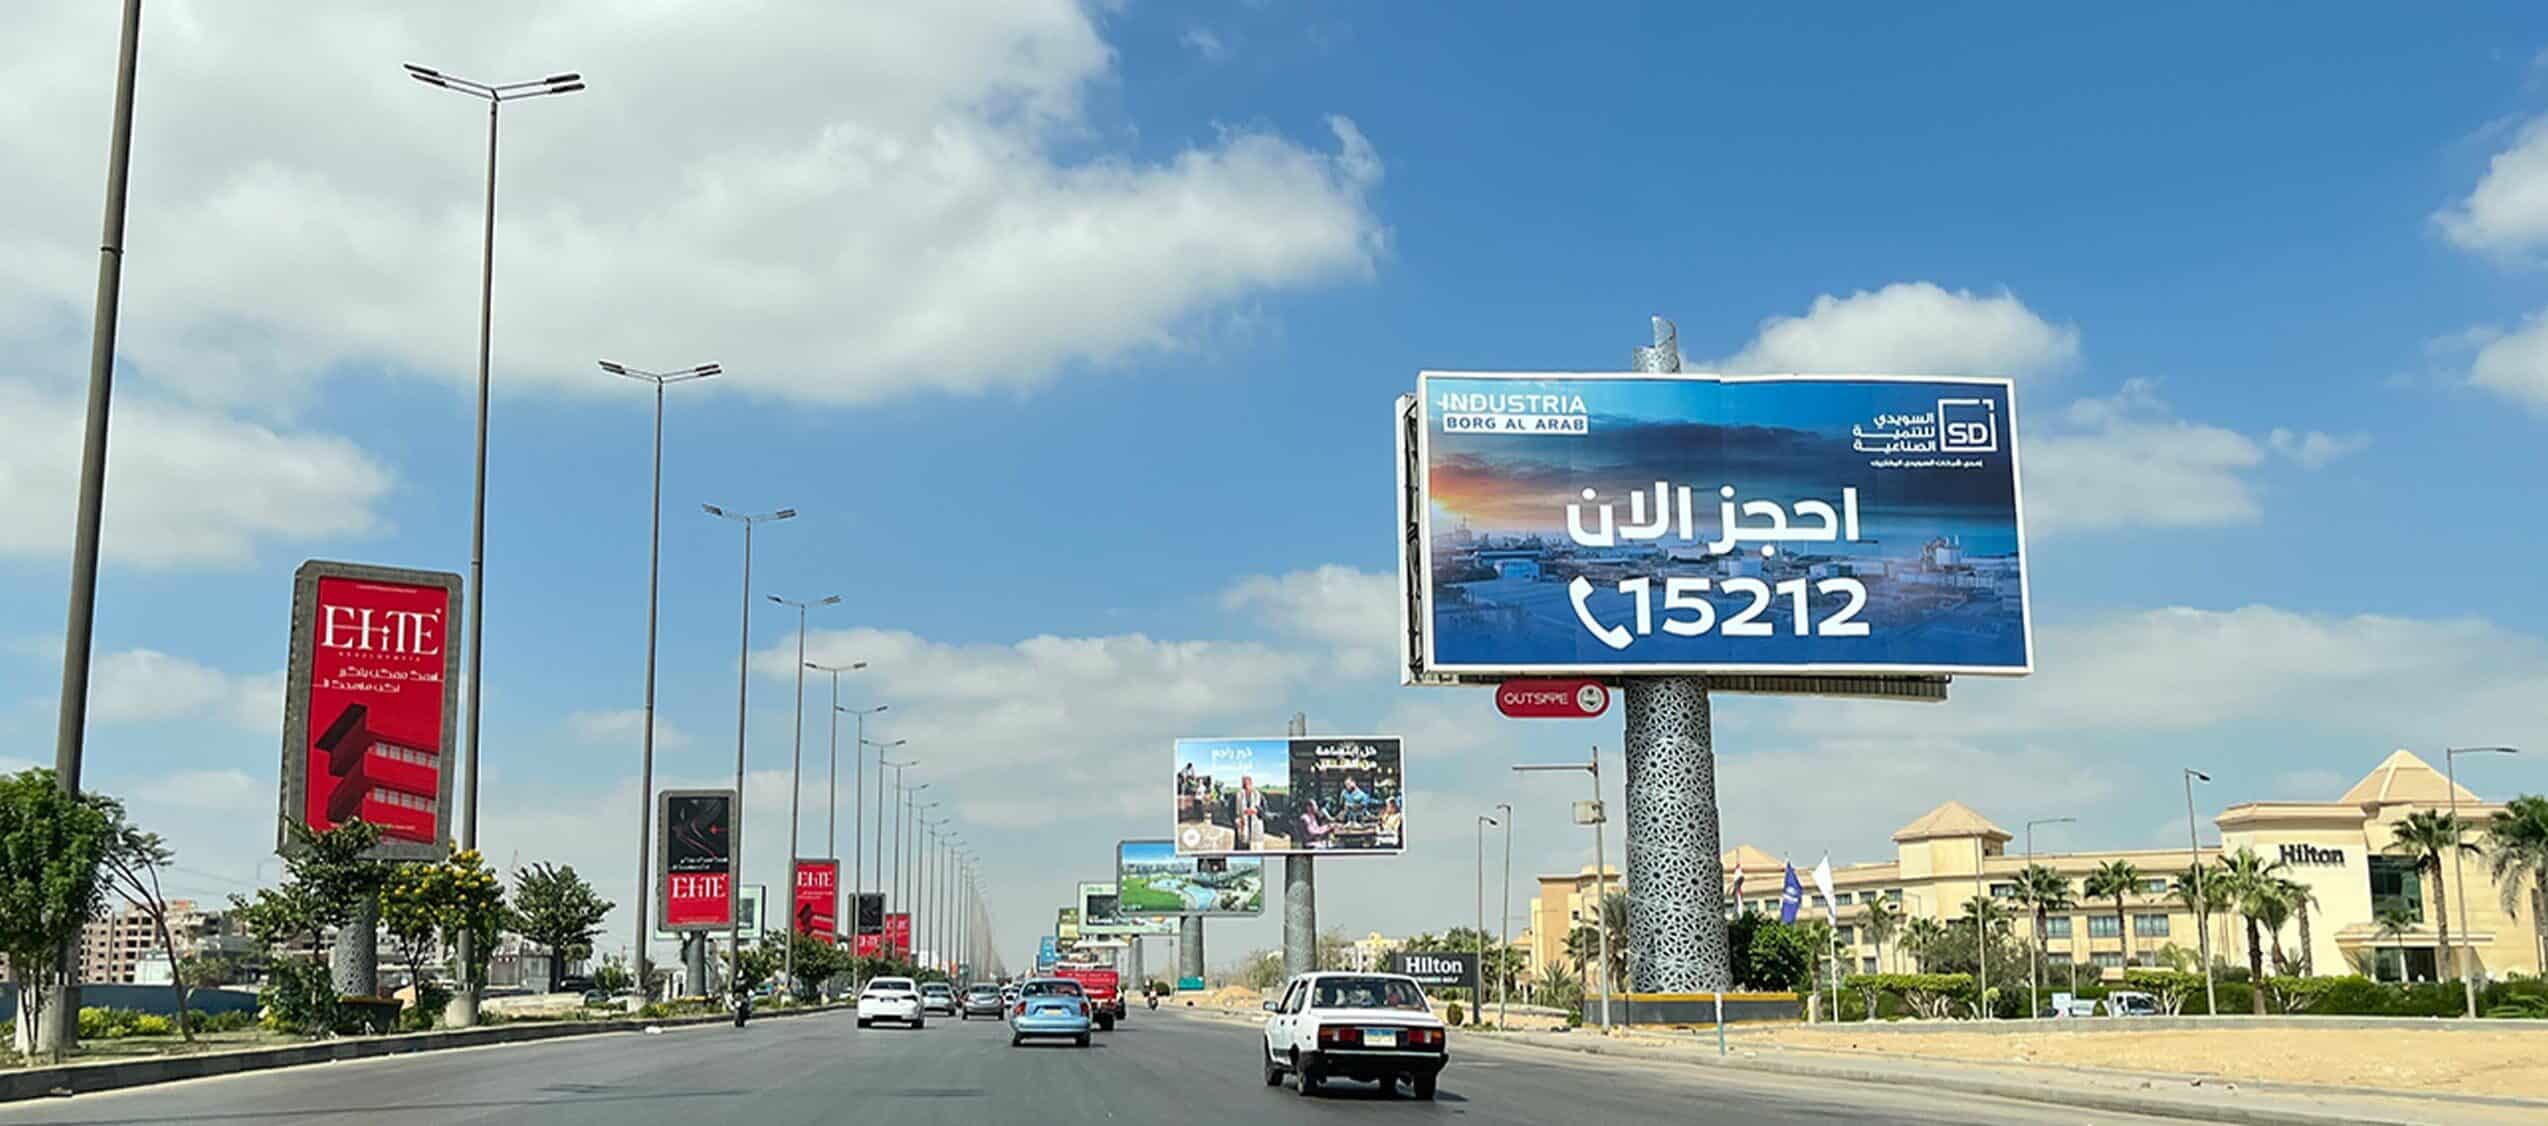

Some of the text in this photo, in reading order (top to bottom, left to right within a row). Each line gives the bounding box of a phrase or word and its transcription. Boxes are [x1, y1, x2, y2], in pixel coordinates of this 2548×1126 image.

[1438, 392, 1587, 414] INDUSTRIA
[1447, 416, 1585, 431] BORG AL ARAB
[1873, 412, 1935, 430] السويدي
[1852, 424, 1936, 439] للتنمية
[1948, 422, 1989, 445] SD
[1853, 439, 1936, 454] الصناعية
[1567, 481, 1860, 557] احجز الان
[1618, 576, 1870, 637] 15212
[2279, 843, 2345, 865] Hilton
[1405, 955, 1463, 974] Hilton
